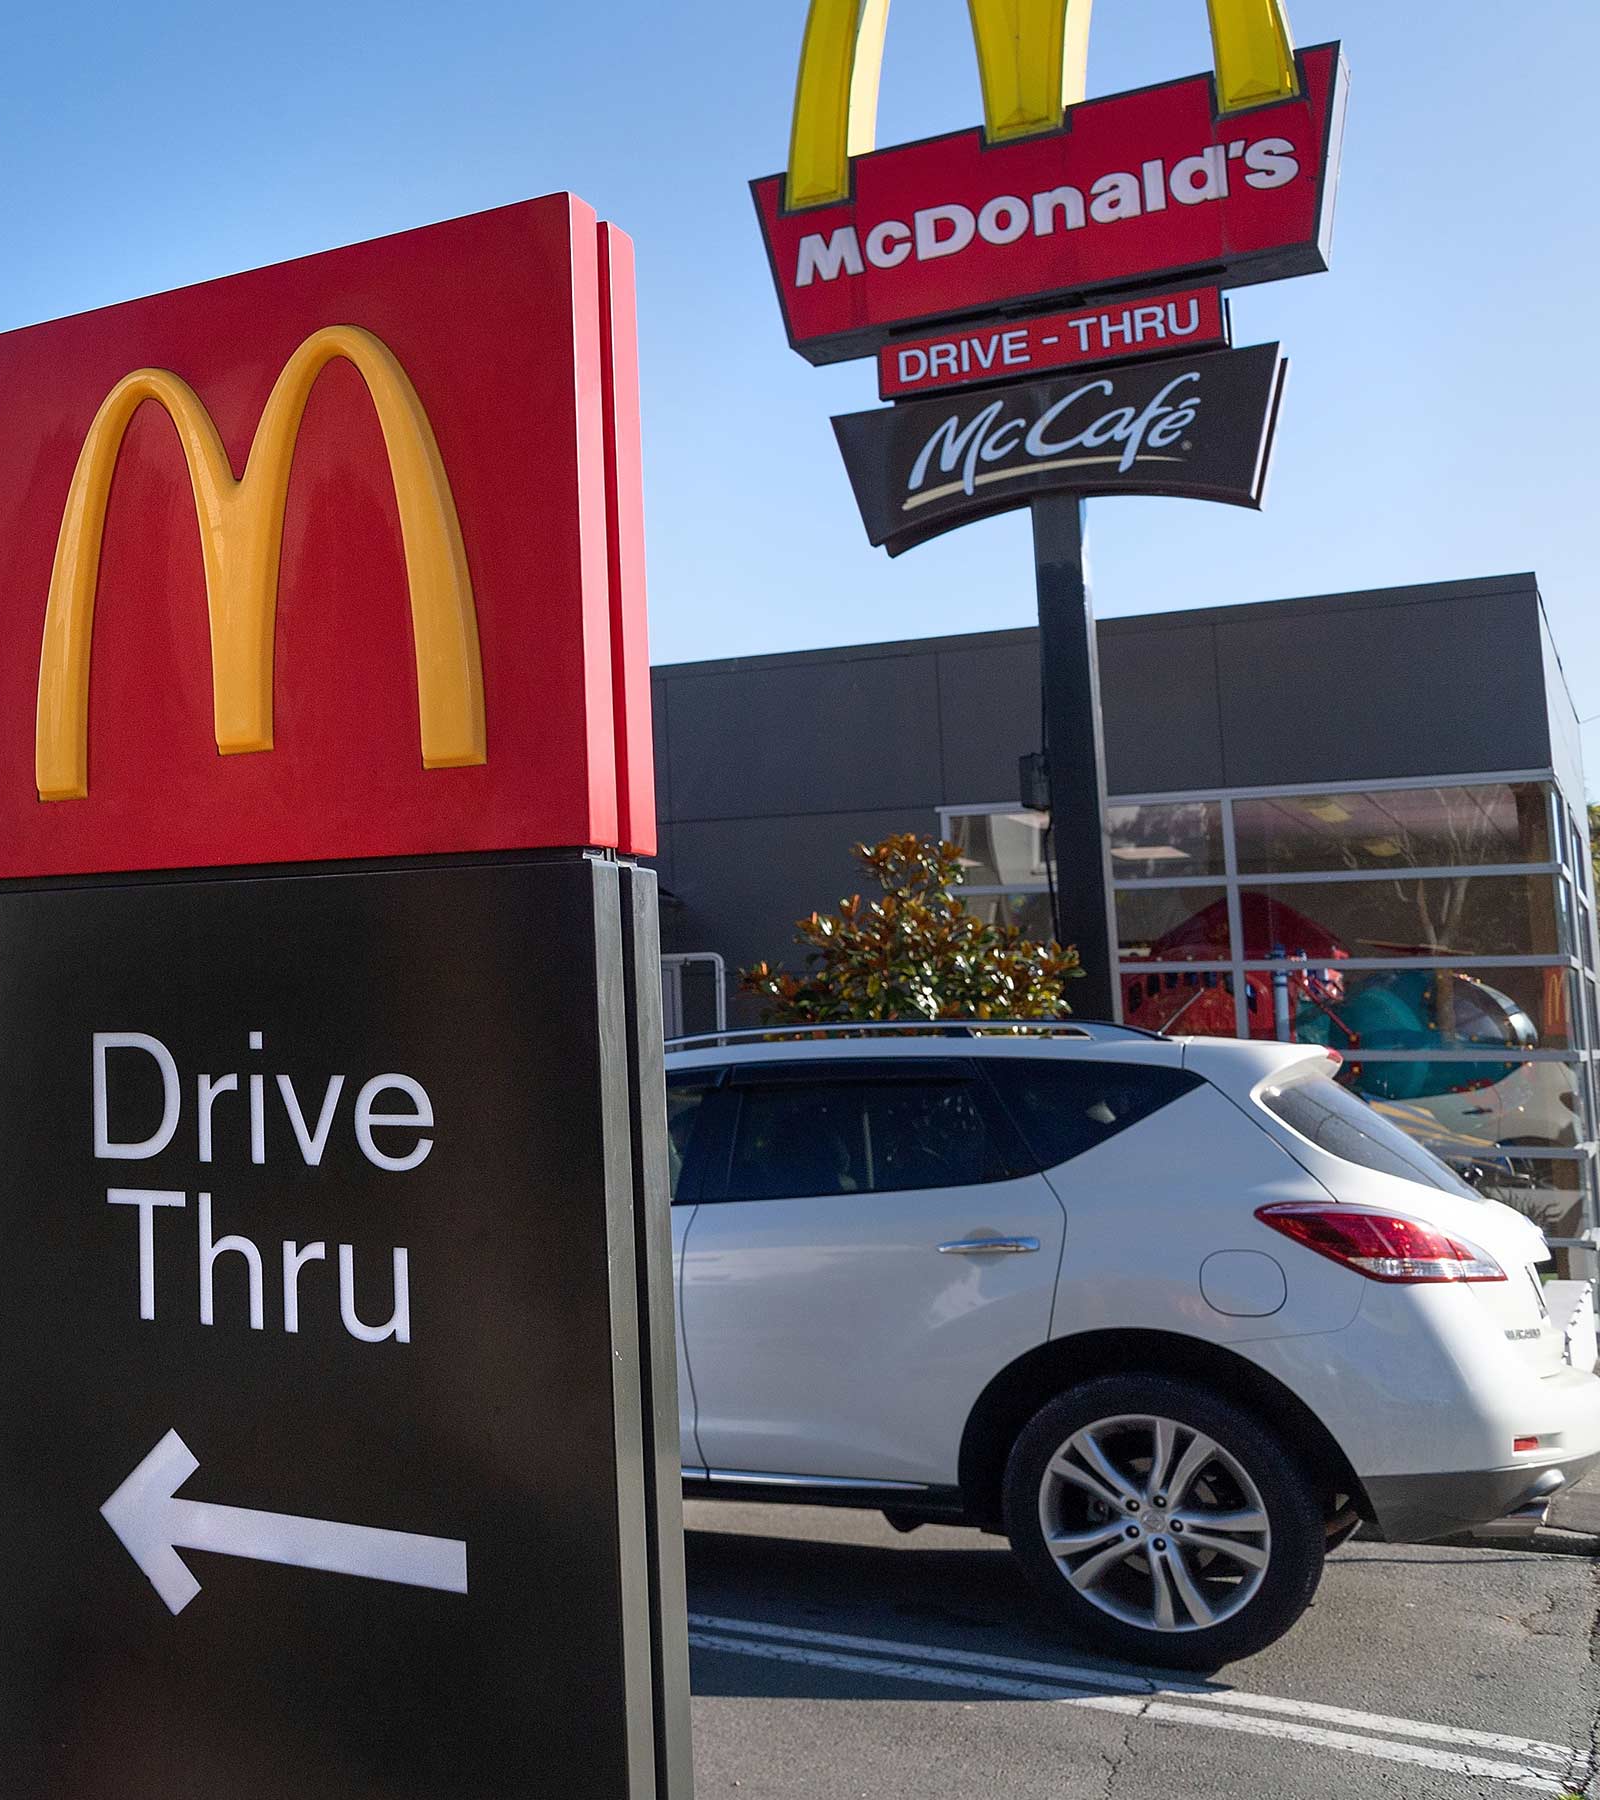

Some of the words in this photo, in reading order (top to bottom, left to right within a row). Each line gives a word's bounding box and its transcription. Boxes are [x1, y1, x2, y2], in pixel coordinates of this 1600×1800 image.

[795, 137, 1299, 287] McDonald's
[898, 329, 1031, 383] DRIVE
[1068, 298, 1200, 352] THRU
[907, 371, 1201, 496] McCafé
[92, 1031, 435, 1172] Drive
[106, 1187, 411, 1343] Thru
